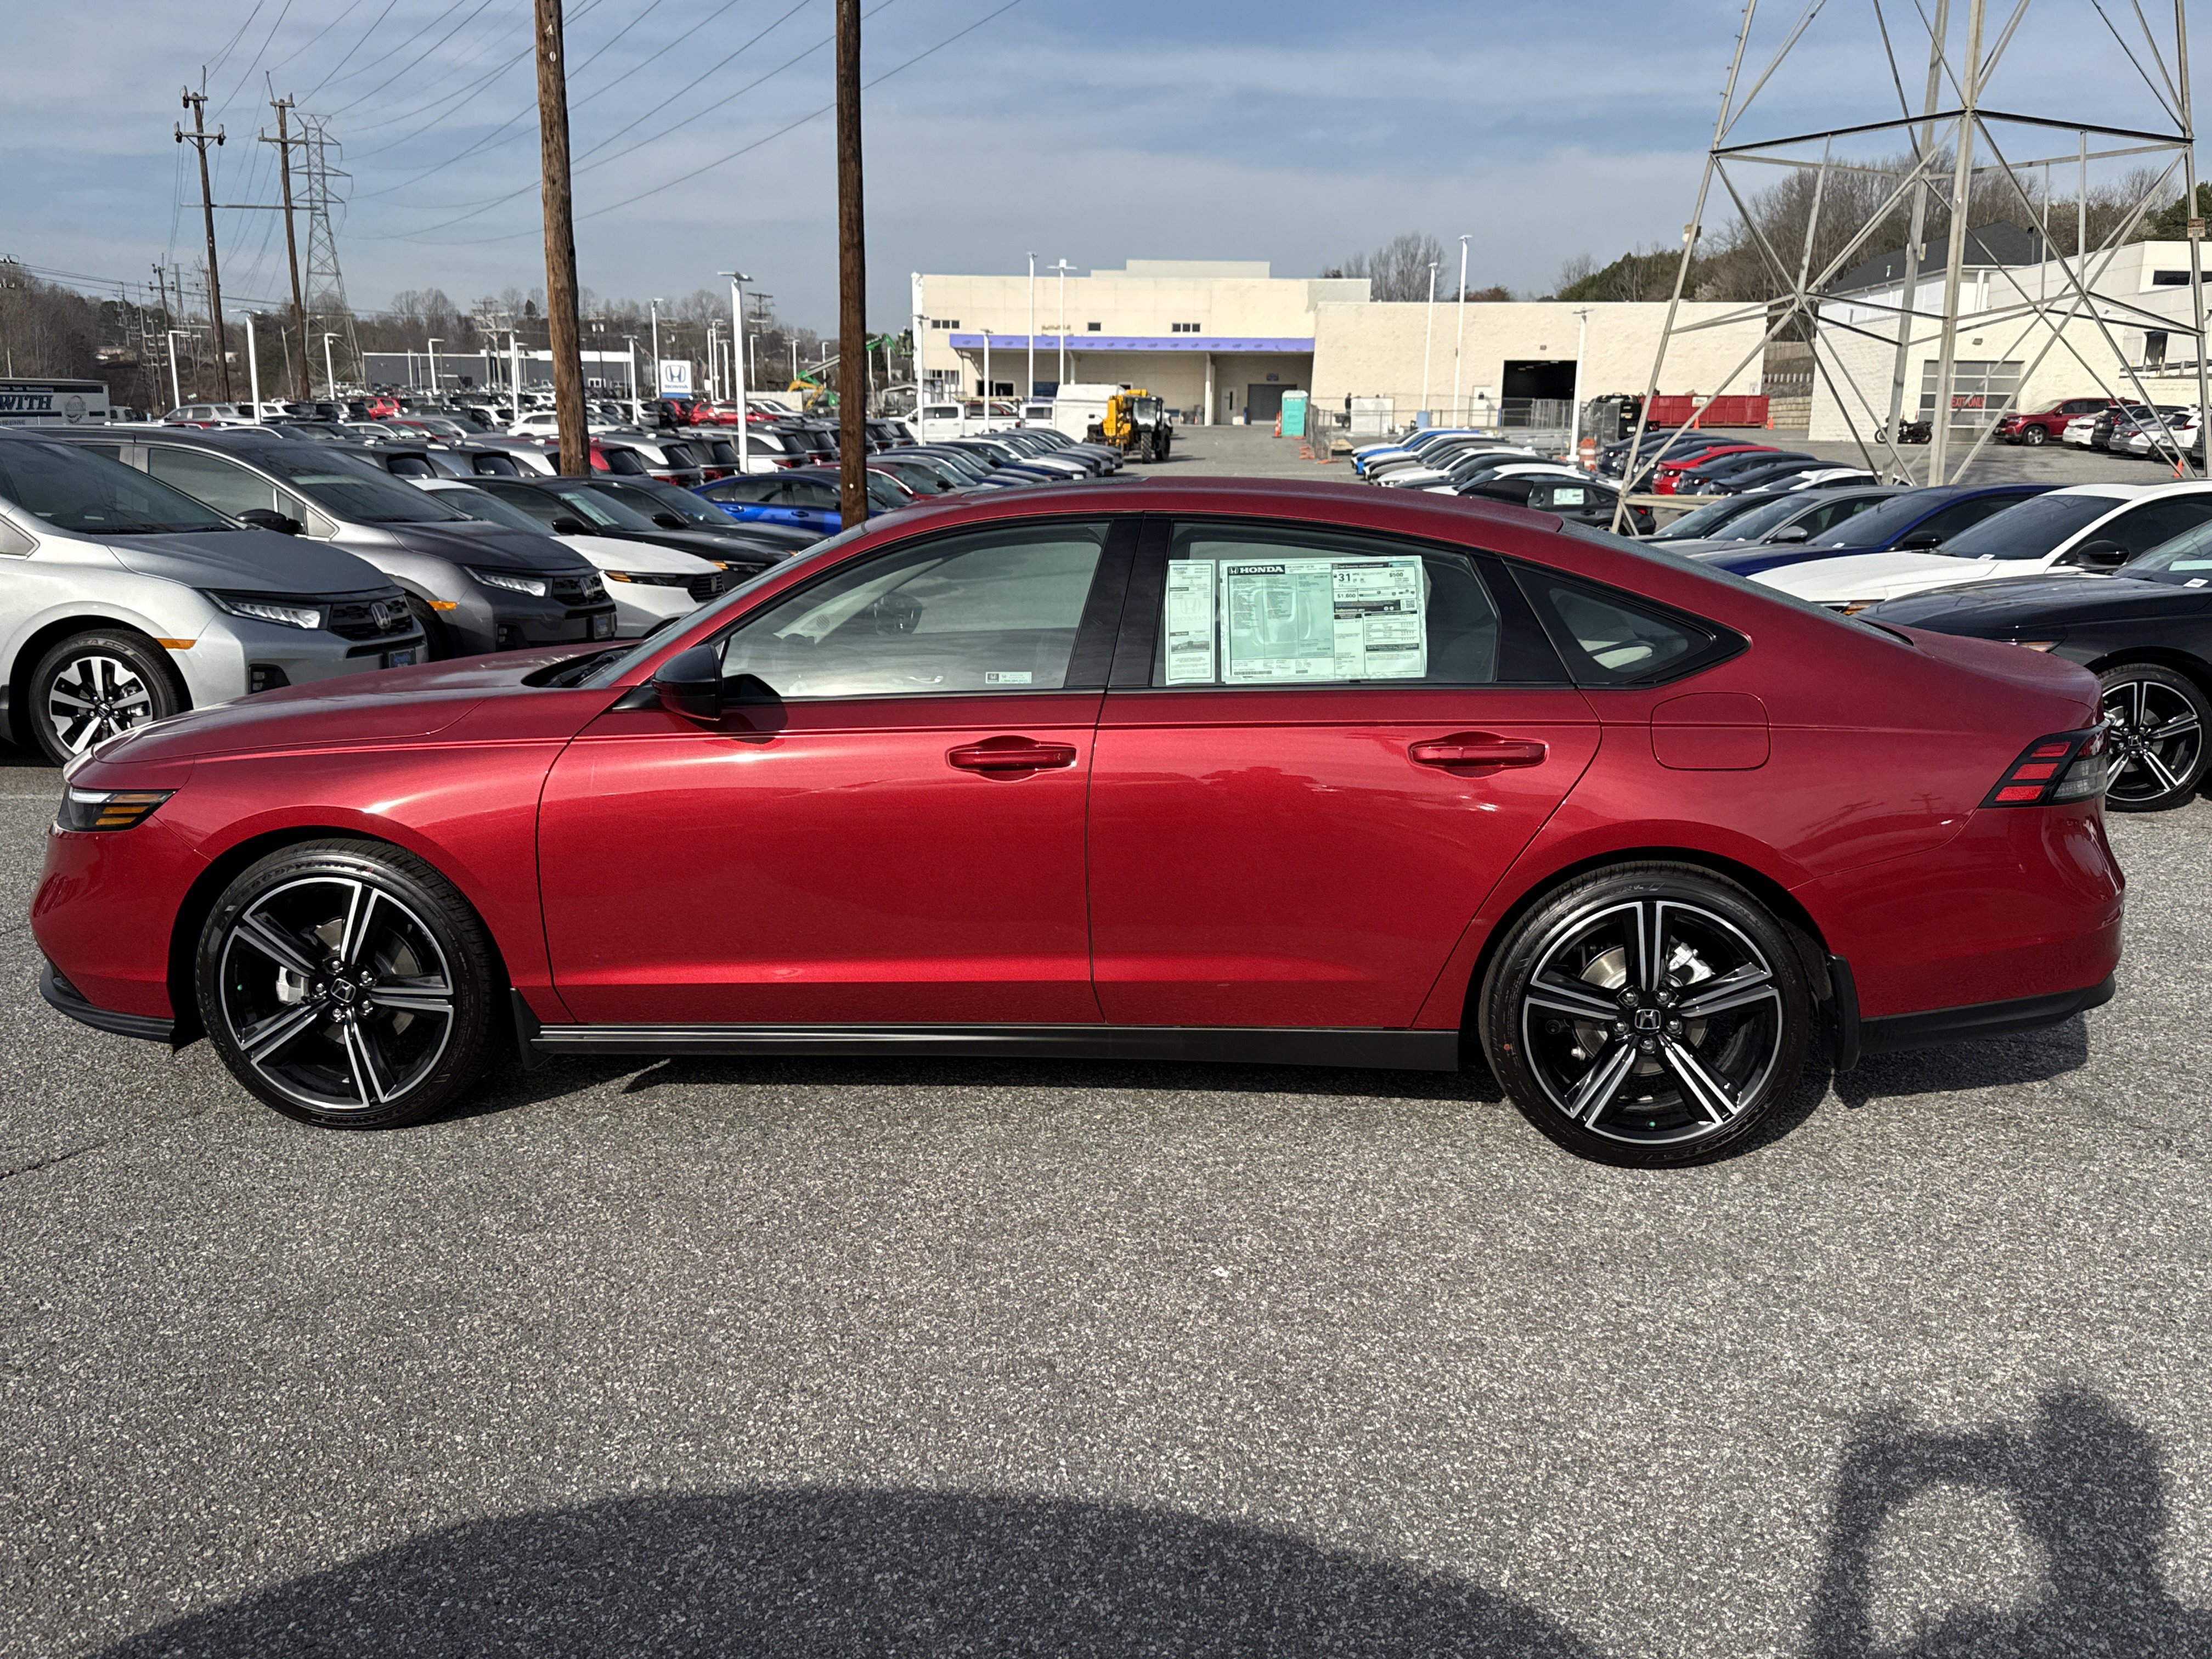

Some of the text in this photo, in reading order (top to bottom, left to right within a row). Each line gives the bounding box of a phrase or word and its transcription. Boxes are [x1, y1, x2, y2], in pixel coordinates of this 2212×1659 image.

[0, 394, 53, 410] WITH
[1950, 396, 1985, 408] EXIT ONLY
[1338, 573, 1350, 582] 31
